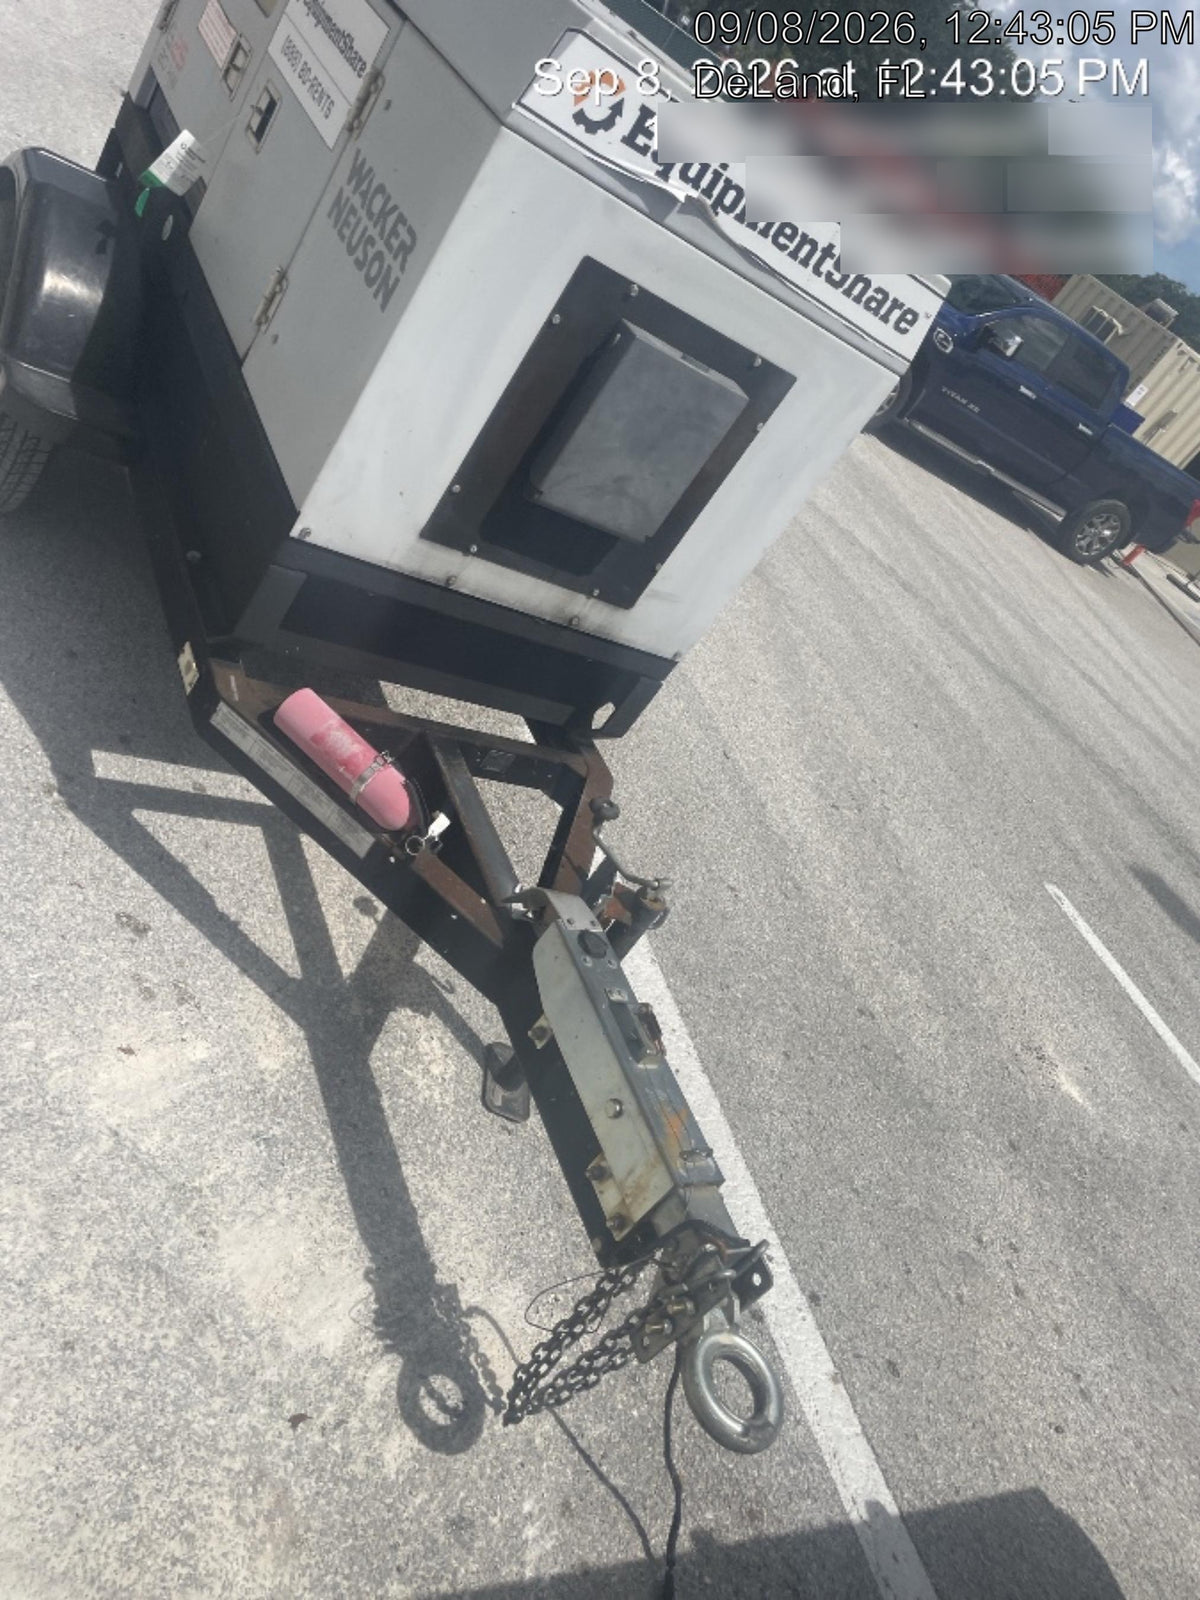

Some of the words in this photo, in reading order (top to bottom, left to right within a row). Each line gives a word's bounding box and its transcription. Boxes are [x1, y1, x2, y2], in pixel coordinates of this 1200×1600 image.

[296, 0, 367, 79] quipmentShare
[327, 186, 401, 314] NEUSON
[346, 147, 418, 275] WACKER
